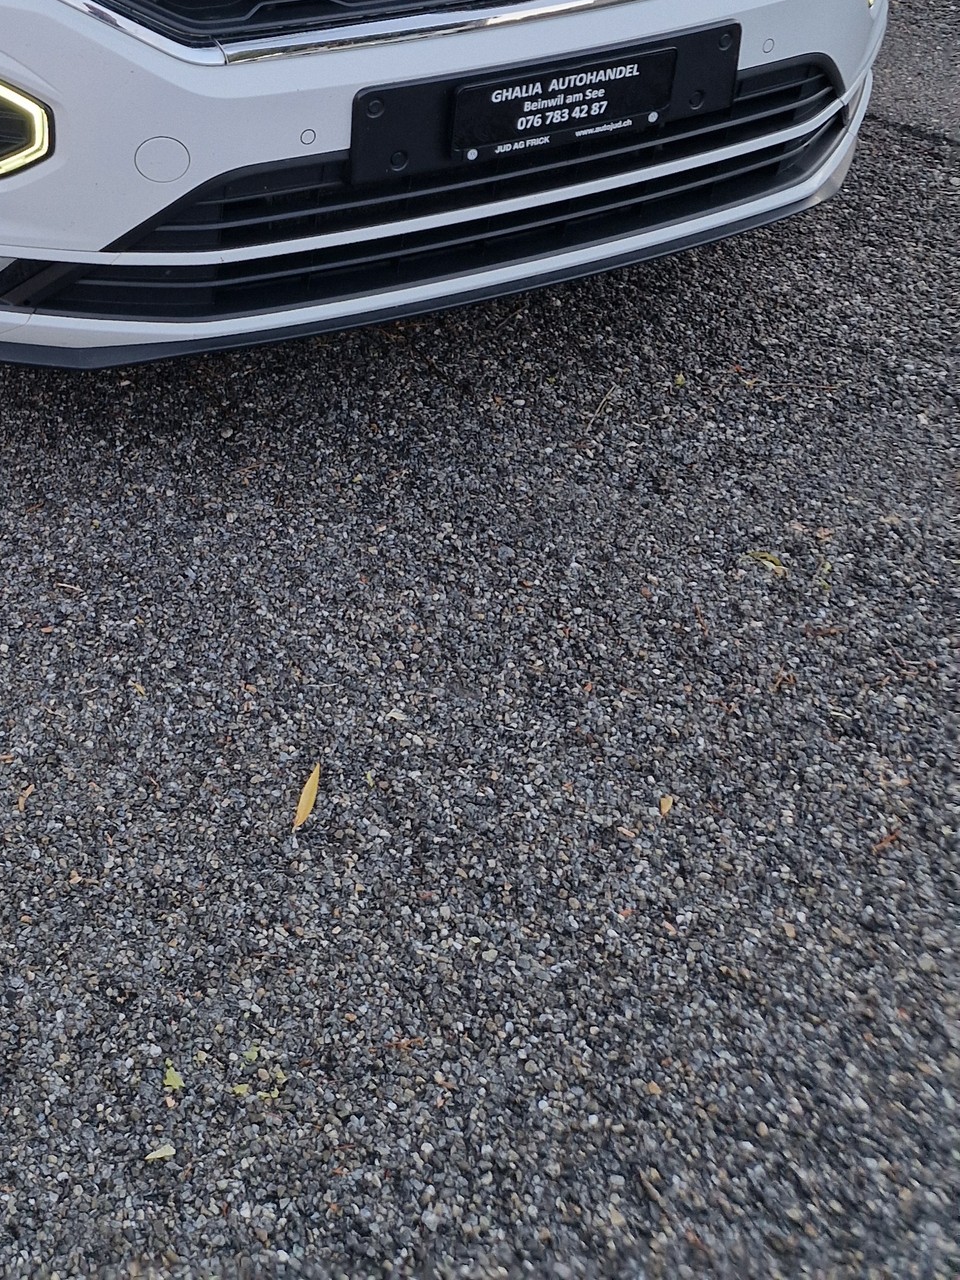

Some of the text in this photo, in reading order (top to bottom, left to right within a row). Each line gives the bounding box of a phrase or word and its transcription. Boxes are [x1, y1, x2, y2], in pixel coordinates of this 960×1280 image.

[491, 63, 640, 103] GHALIA AUTOHANDEL
[523, 87, 605, 112] Beinwil am See
[517, 100, 608, 131] 076 783 42 87
[574, 118, 633, 137] www.autojud.ch
[494, 135, 551, 154] JUD AG FRICK
